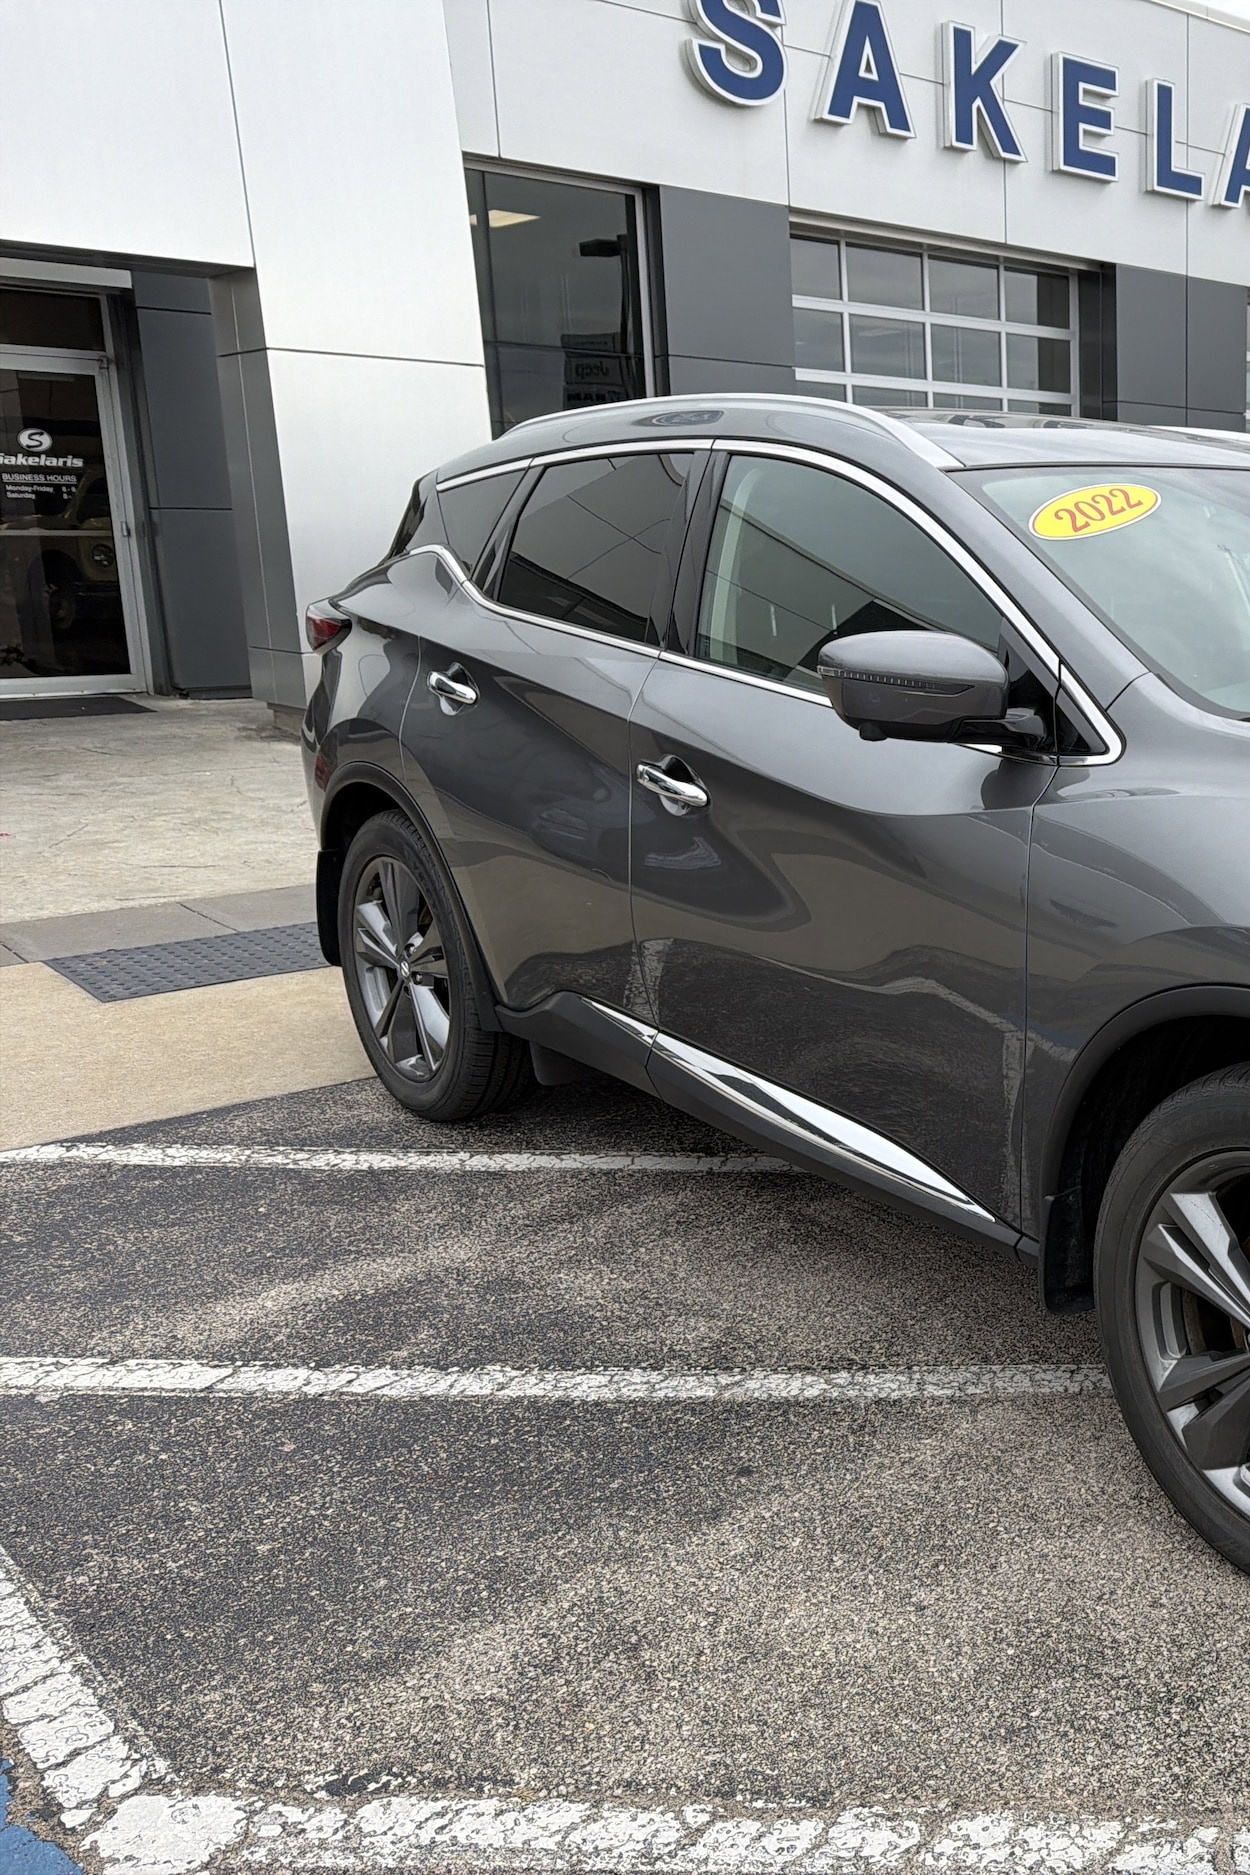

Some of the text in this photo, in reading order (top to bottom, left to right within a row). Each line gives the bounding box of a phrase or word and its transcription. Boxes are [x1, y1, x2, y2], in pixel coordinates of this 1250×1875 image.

[1, 473, 77, 482] BUSINESS HOURS
[5, 484, 54, 493] Monday-Friday
[1054, 488, 1143, 533] 2022
